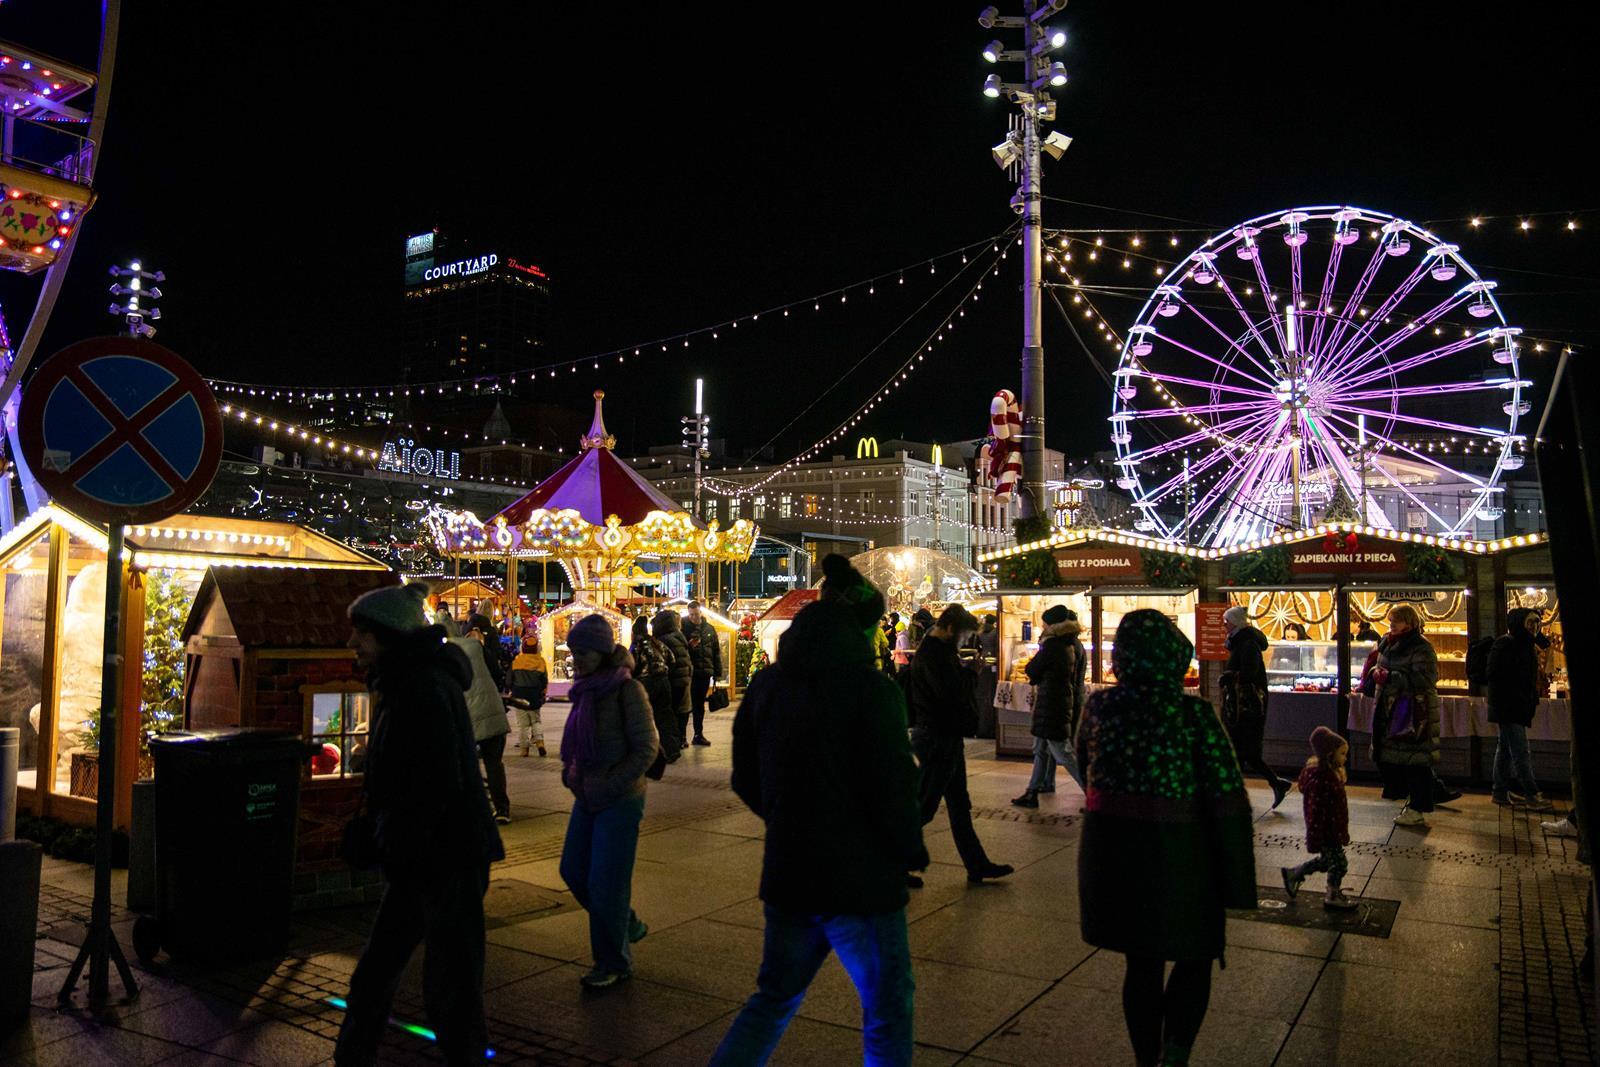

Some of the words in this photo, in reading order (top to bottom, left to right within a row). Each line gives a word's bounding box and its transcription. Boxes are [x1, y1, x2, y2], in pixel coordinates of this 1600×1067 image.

[424, 254, 498, 280] COURTYARD
[1263, 480, 1328, 497] Katwice
[1058, 560, 1078, 568] SERY
[1080, 560, 1086, 568] Z
[1087, 558, 1131, 568] PODHALA
[1294, 554, 1352, 563] ZAPIEKANKI
[1355, 554, 1362, 562] Z
[1364, 553, 1396, 562] PIECA
